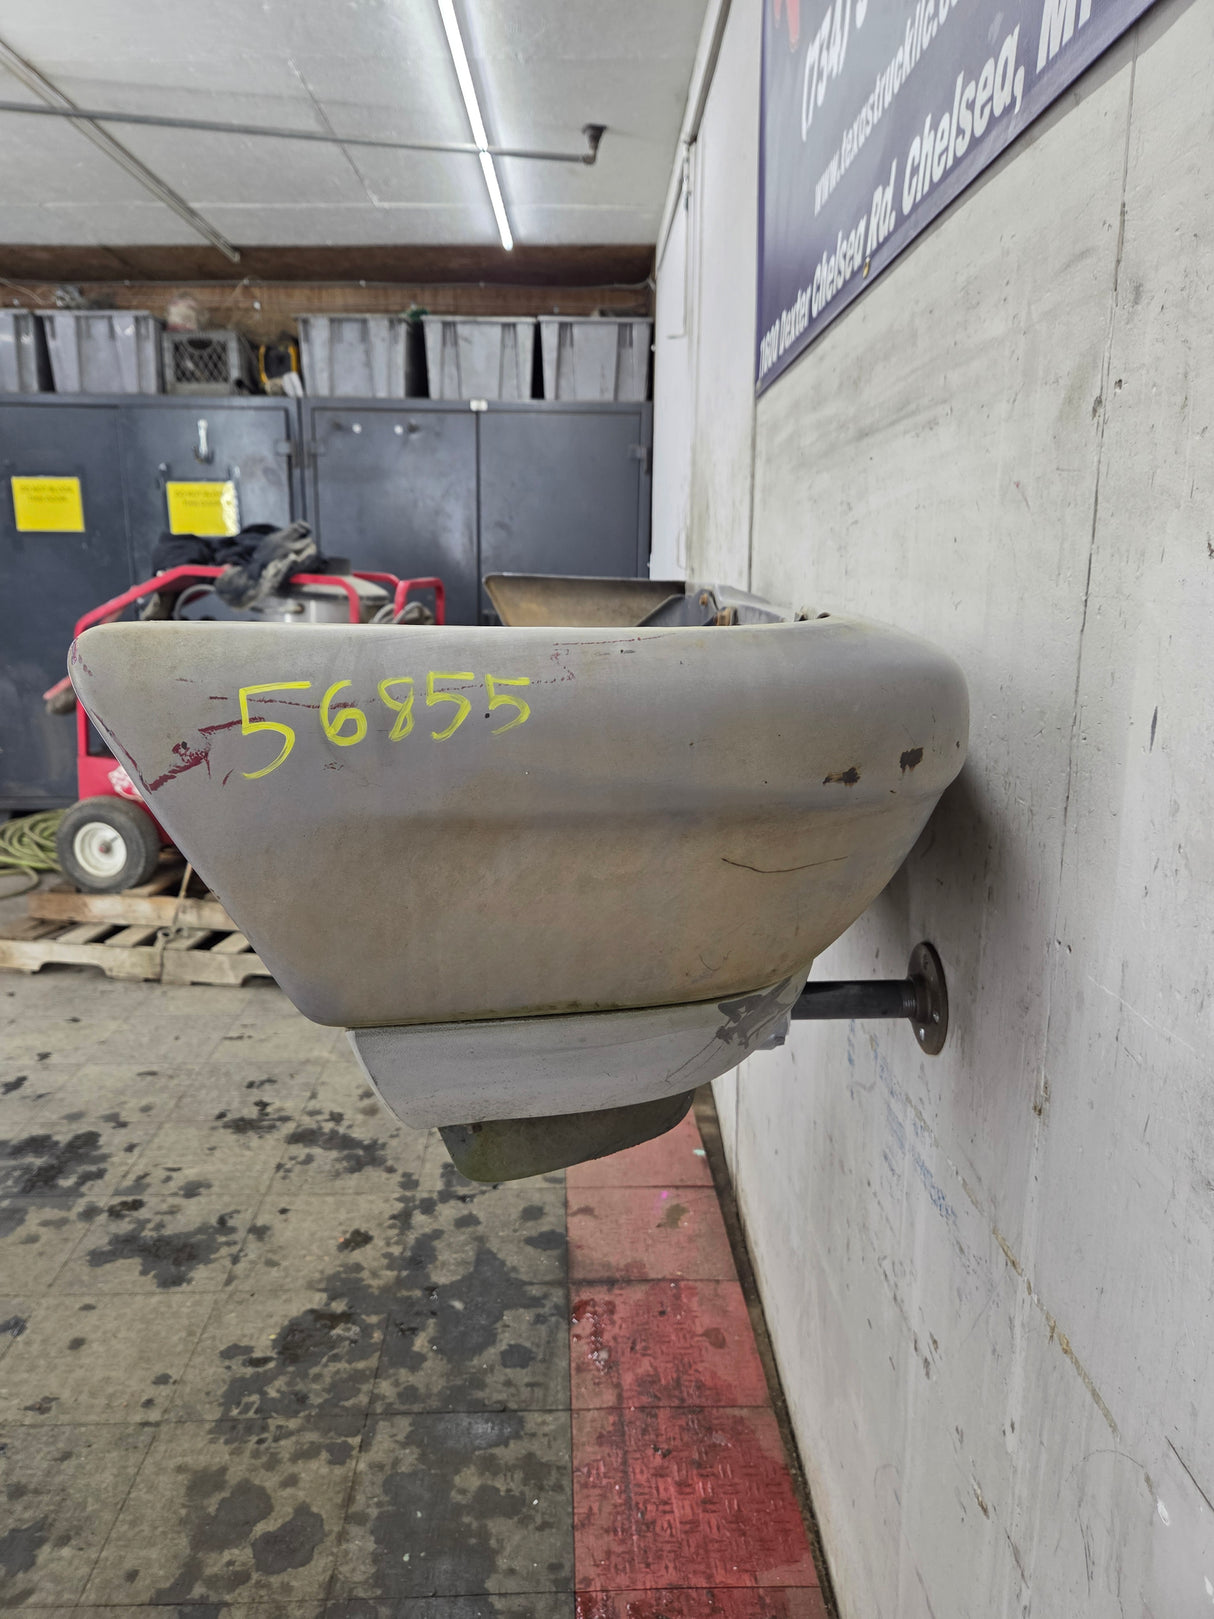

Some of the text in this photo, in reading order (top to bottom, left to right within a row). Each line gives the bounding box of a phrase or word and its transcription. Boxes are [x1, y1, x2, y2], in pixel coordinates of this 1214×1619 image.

[779, 284, 812, 356] Dexter
[812, 210, 869, 319] Chelsea
[866, 159, 896, 256] Rd.
[902, 24, 1024, 216] Chelsea,
[1036, 0, 1092, 74] M
[238, 671, 531, 779] 56855
